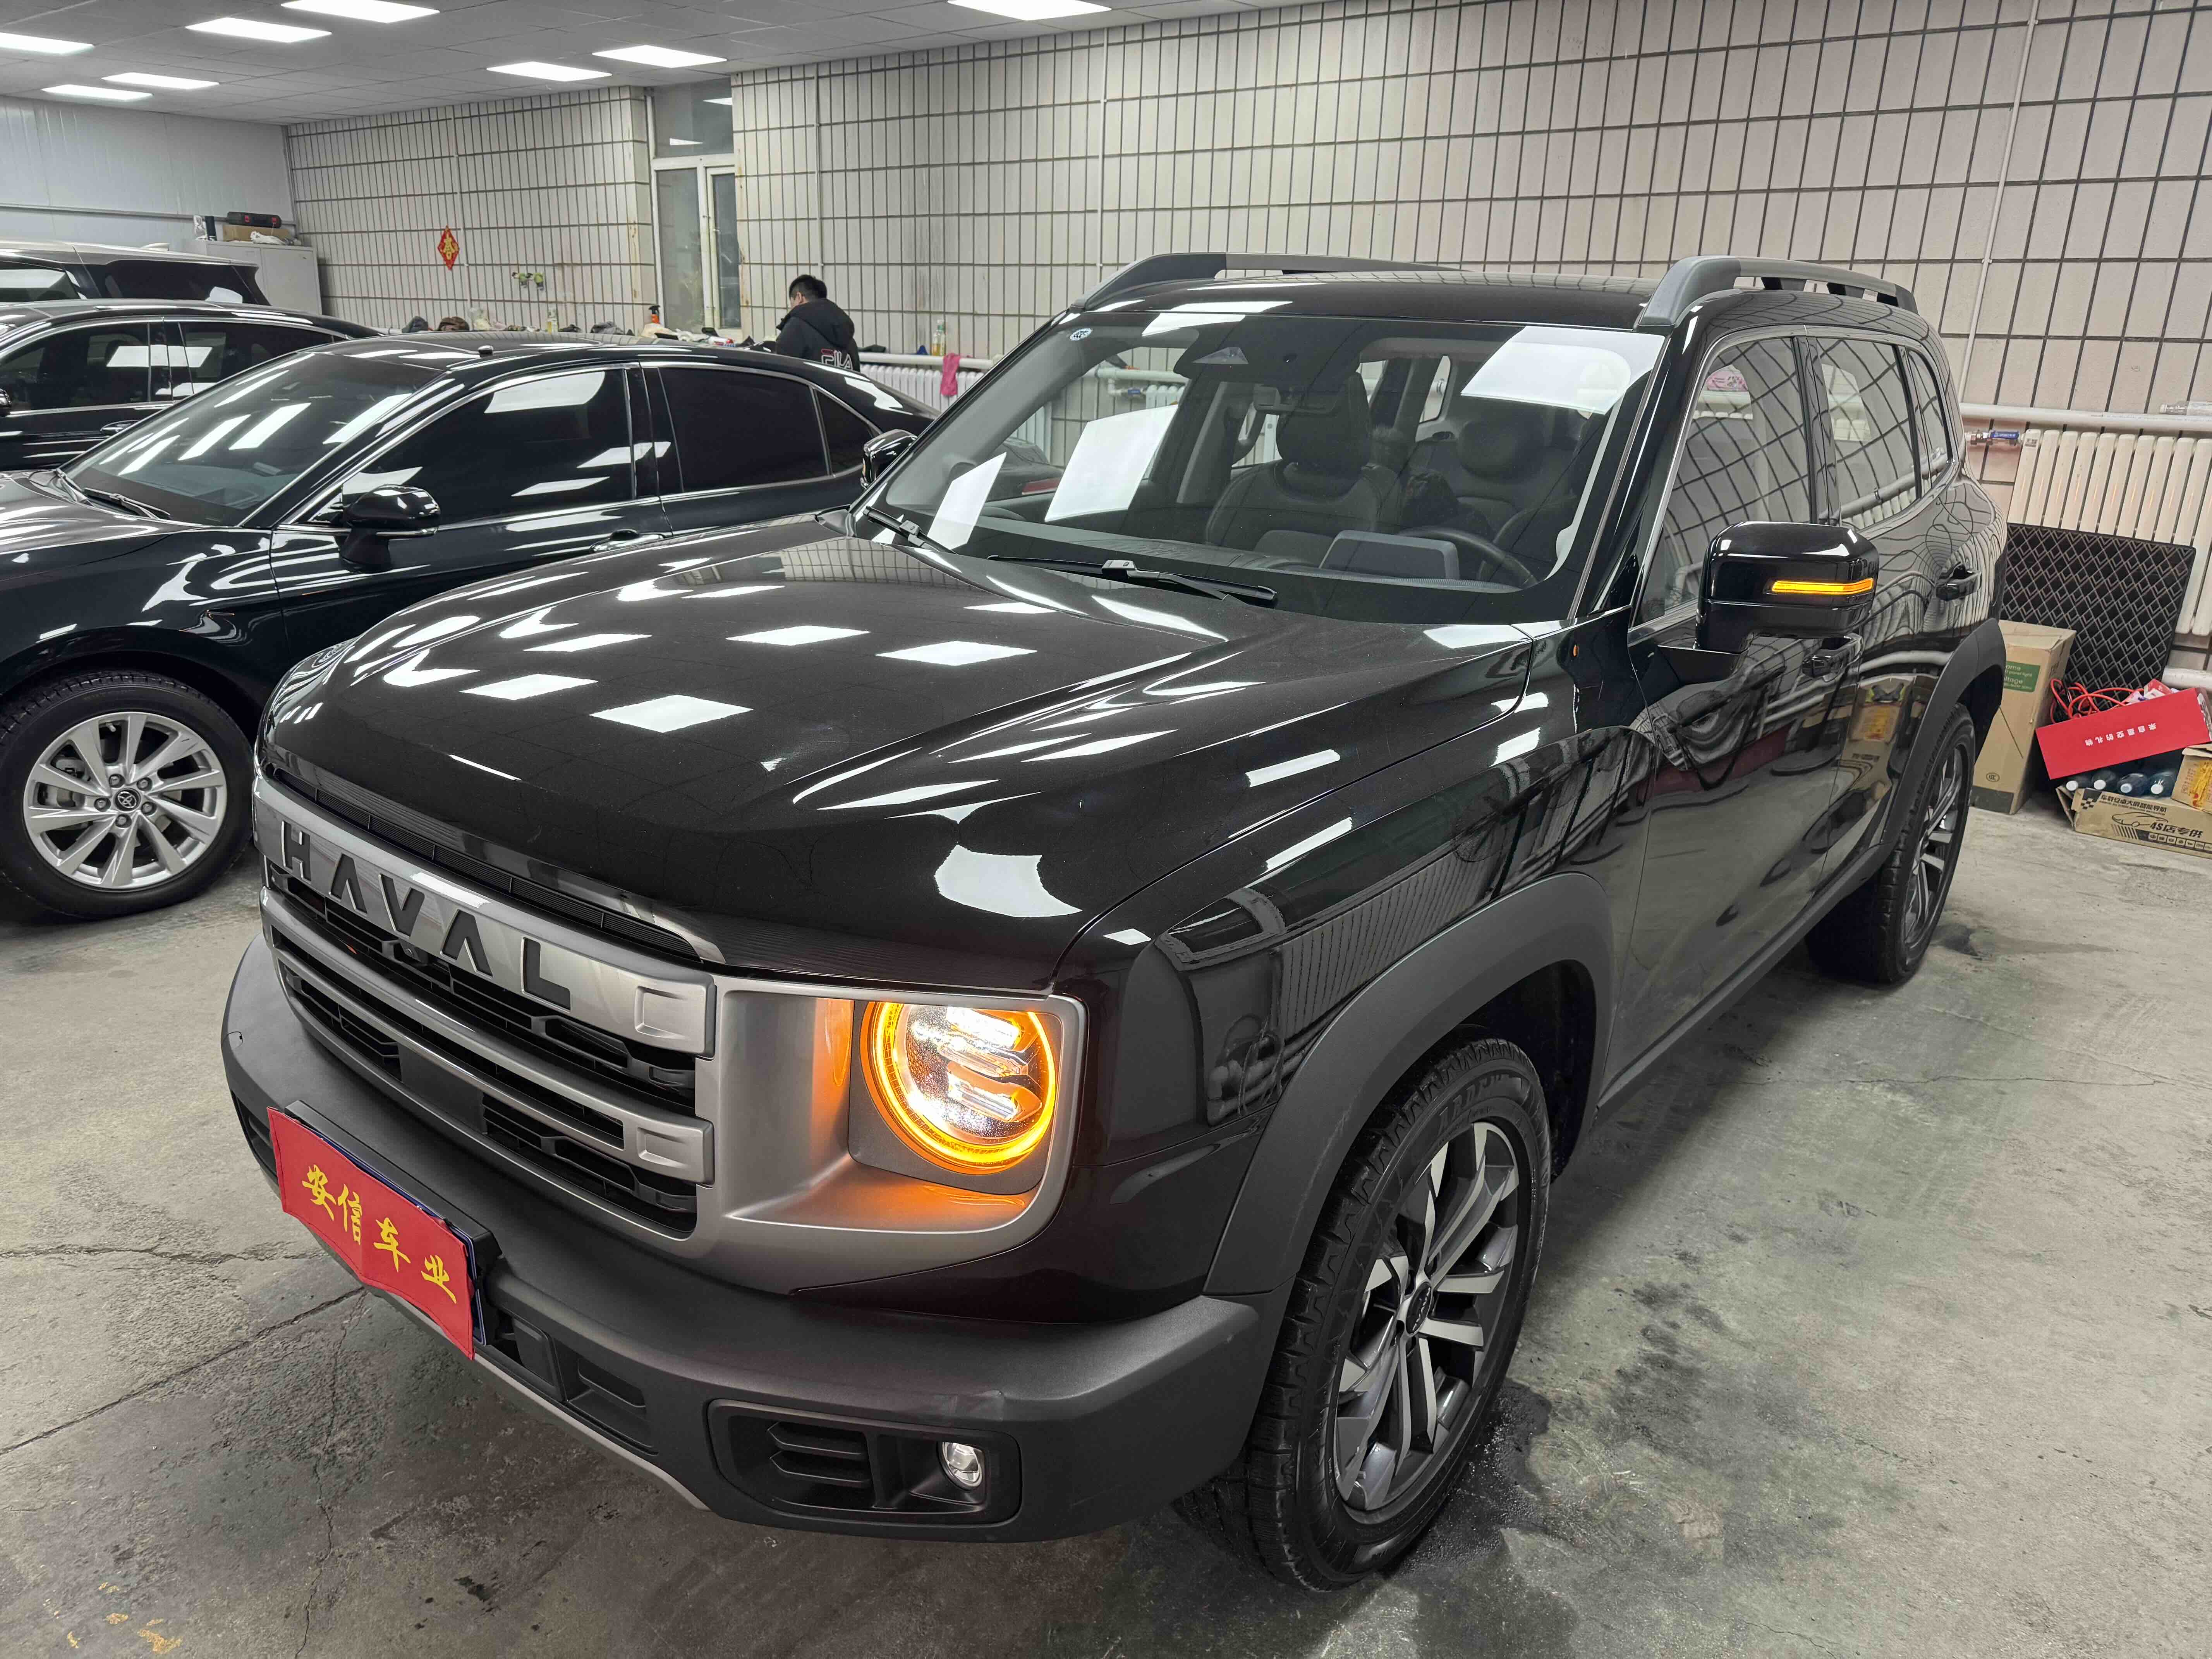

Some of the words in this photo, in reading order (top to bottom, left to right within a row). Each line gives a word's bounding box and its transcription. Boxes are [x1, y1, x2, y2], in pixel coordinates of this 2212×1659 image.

[821, 348, 853, 371] FILA
[2085, 723, 2157, 746] 来自星空的礼物
[2150, 822, 2203, 838] 4S店专供
[281, 821, 571, 1012] HAVAL
[302, 1164, 457, 1304] 安信车业
